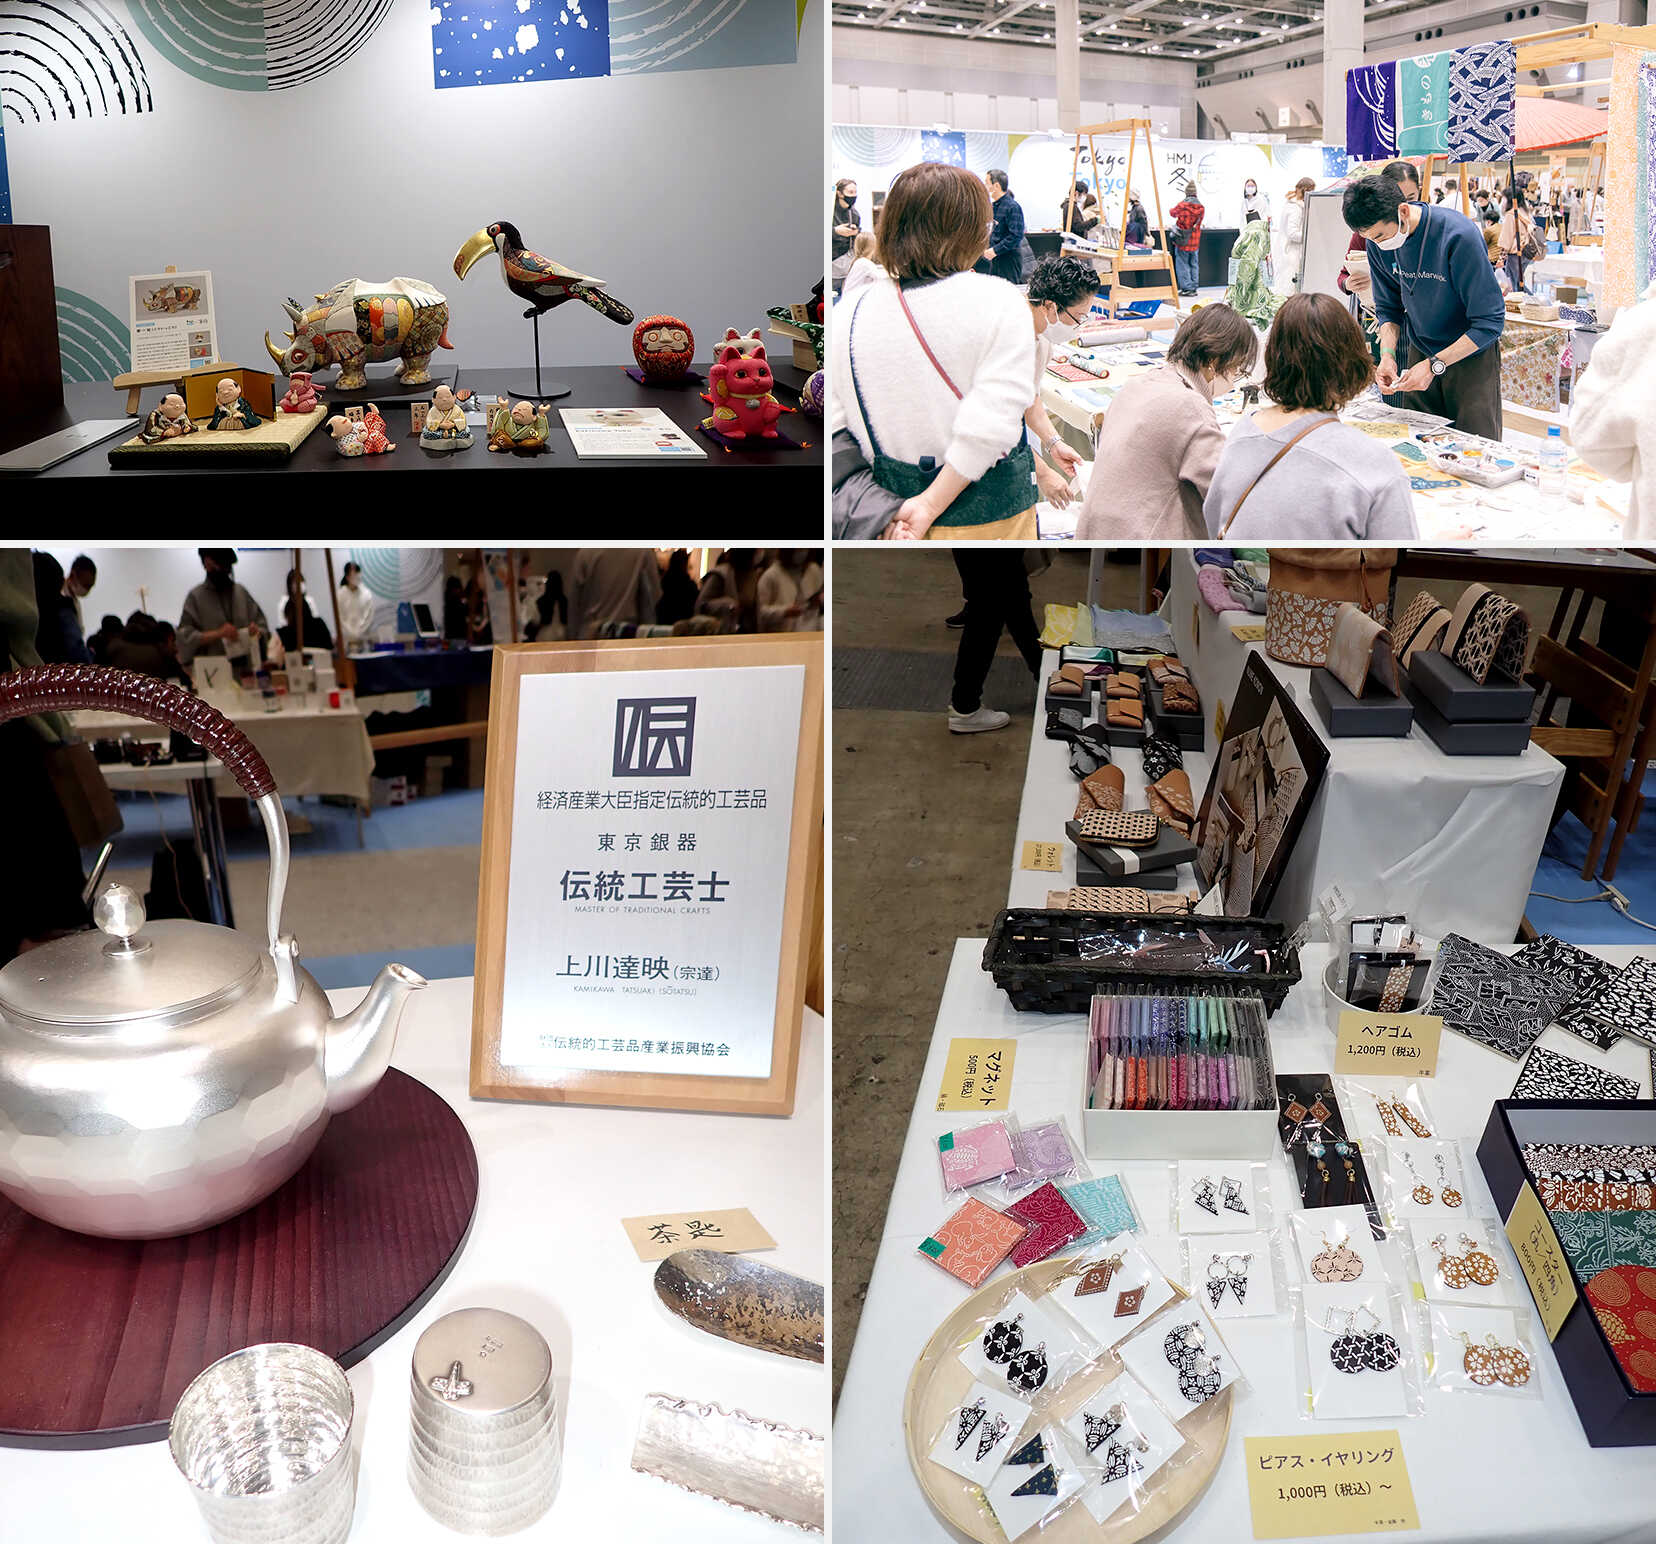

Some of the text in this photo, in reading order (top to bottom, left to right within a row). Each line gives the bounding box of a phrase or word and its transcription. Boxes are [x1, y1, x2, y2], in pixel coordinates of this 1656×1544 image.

[1167, 153, 1193, 165] HMJ
[1167, 167, 1190, 193] 冬
[536, 789, 767, 810] 経済産業大臣指定伝統的工芸品
[597, 832, 697, 852] 東京銀器
[559, 869, 730, 902] 伝統工芸士
[574, 905, 711, 915] MASTER OF TRADITIONAL CRAFTS
[573, 985, 615, 993] KAMIKAWA
[1361, 1025, 1413, 1039] ヘアゴム
[1347, 1044, 1421, 1058] 1,200円（税込）
[960, 1054, 979, 1099] 500円（税込）
[979, 1050, 1002, 1106] マグネット
[647, 1220, 725, 1244] 茶匙
[1534, 1218, 1564, 1285] コースター
[1259, 1447, 1395, 1470] ピアス・イヤリング
